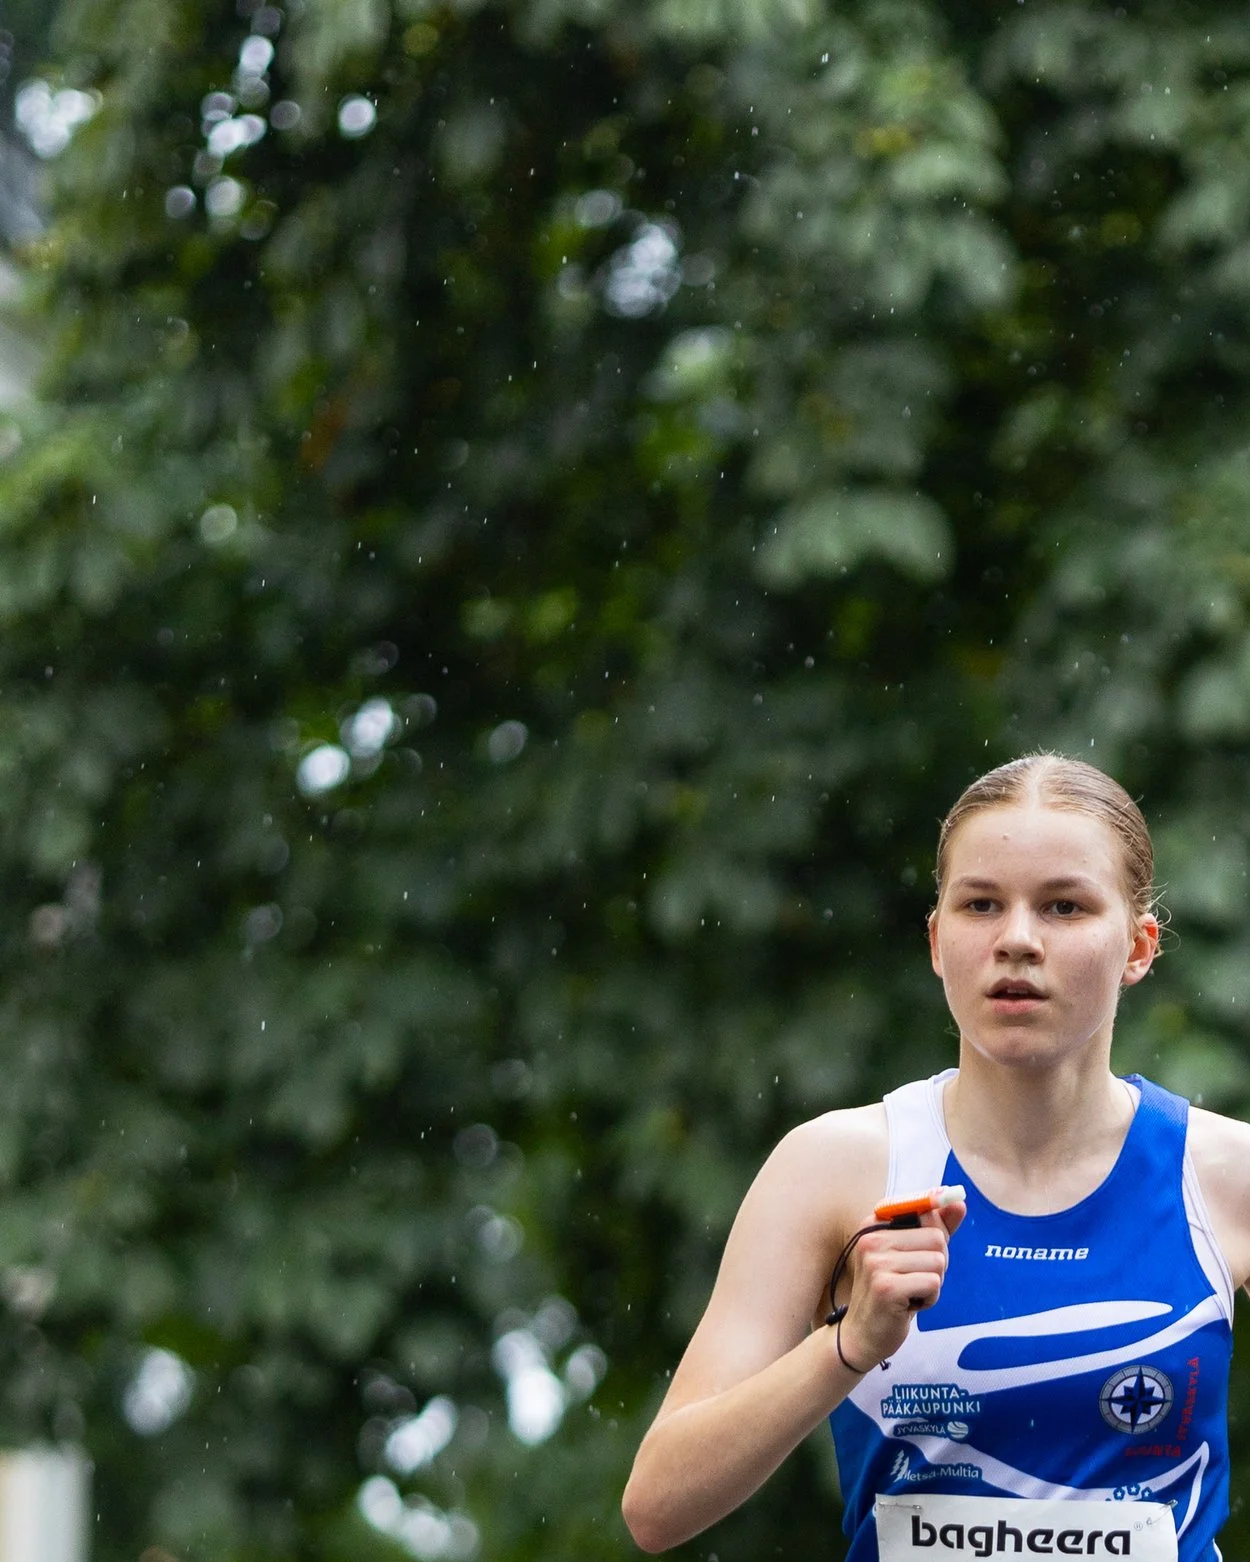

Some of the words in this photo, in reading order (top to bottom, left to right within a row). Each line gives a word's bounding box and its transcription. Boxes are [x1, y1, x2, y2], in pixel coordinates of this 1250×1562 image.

[985, 1244, 1090, 1261] noname
[894, 1386, 966, 1400] LIIKUNTA-
[882, 1399, 981, 1416] PÄÄKAUPUNKI
[911, 1514, 1132, 1558] bagheera
